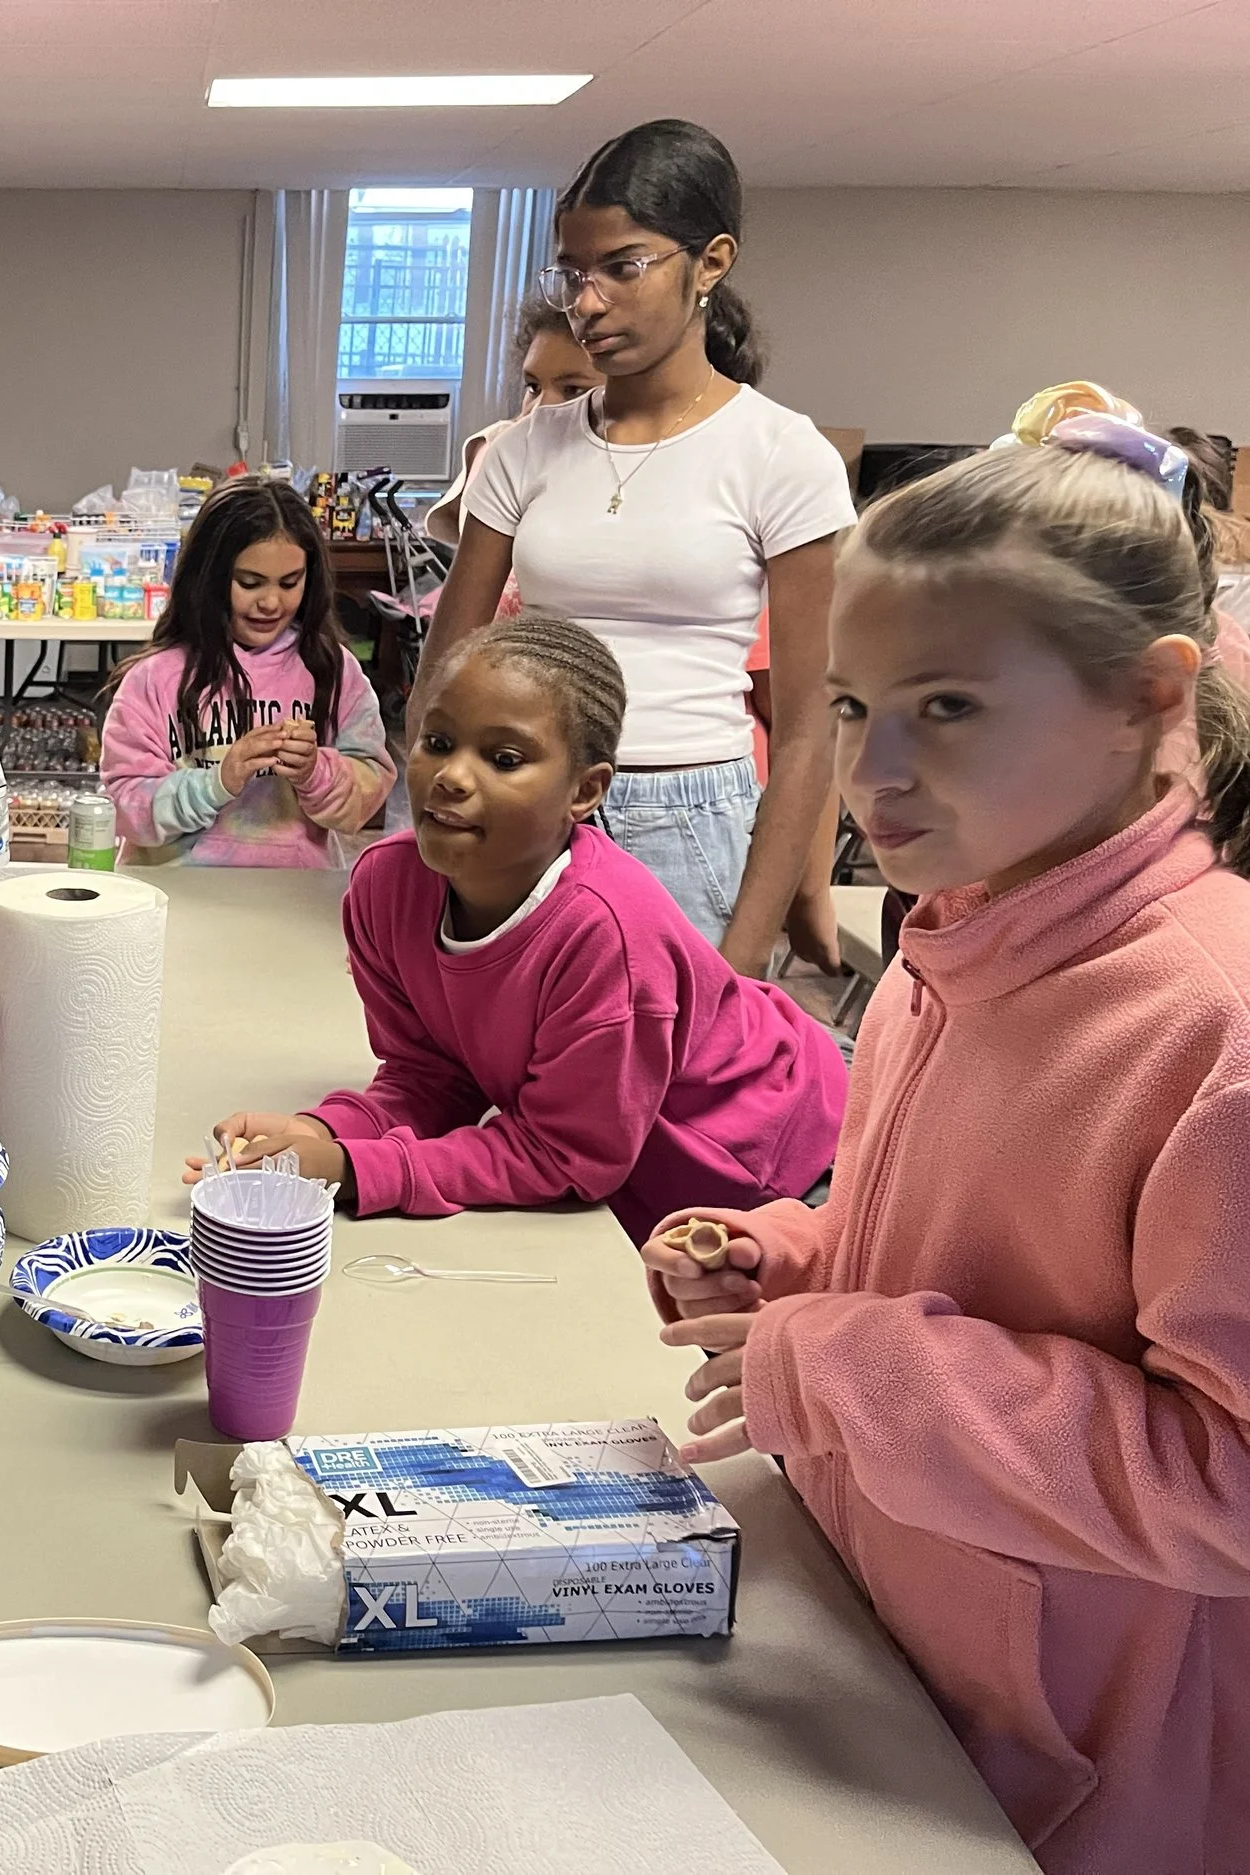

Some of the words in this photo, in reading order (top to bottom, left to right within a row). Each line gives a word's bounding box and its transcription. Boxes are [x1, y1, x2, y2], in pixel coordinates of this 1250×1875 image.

[519, 1430, 557, 1439] EXTRA
[562, 1428, 603, 1436] LARGE
[607, 1423, 649, 1435] CLEAR
[576, 1439, 607, 1447] EXAM
[611, 1436, 657, 1445] GLOVES
[320, 1450, 367, 1463] DRE
[328, 1492, 418, 1519] XL
[344, 1524, 393, 1537] ATEX
[397, 1523, 410, 1533] &
[345, 1536, 421, 1550] POWDER
[426, 1533, 468, 1545] FREE
[586, 1561, 607, 1573] 100
[611, 1561, 641, 1572] Extra
[647, 1560, 678, 1570] Large
[553, 1576, 606, 1587] DISPOSABLE
[552, 1586, 599, 1598] VINYL
[604, 1584, 648, 1595] EXAM
[653, 1582, 715, 1594] GLOVES
[353, 1584, 438, 1631] XL
